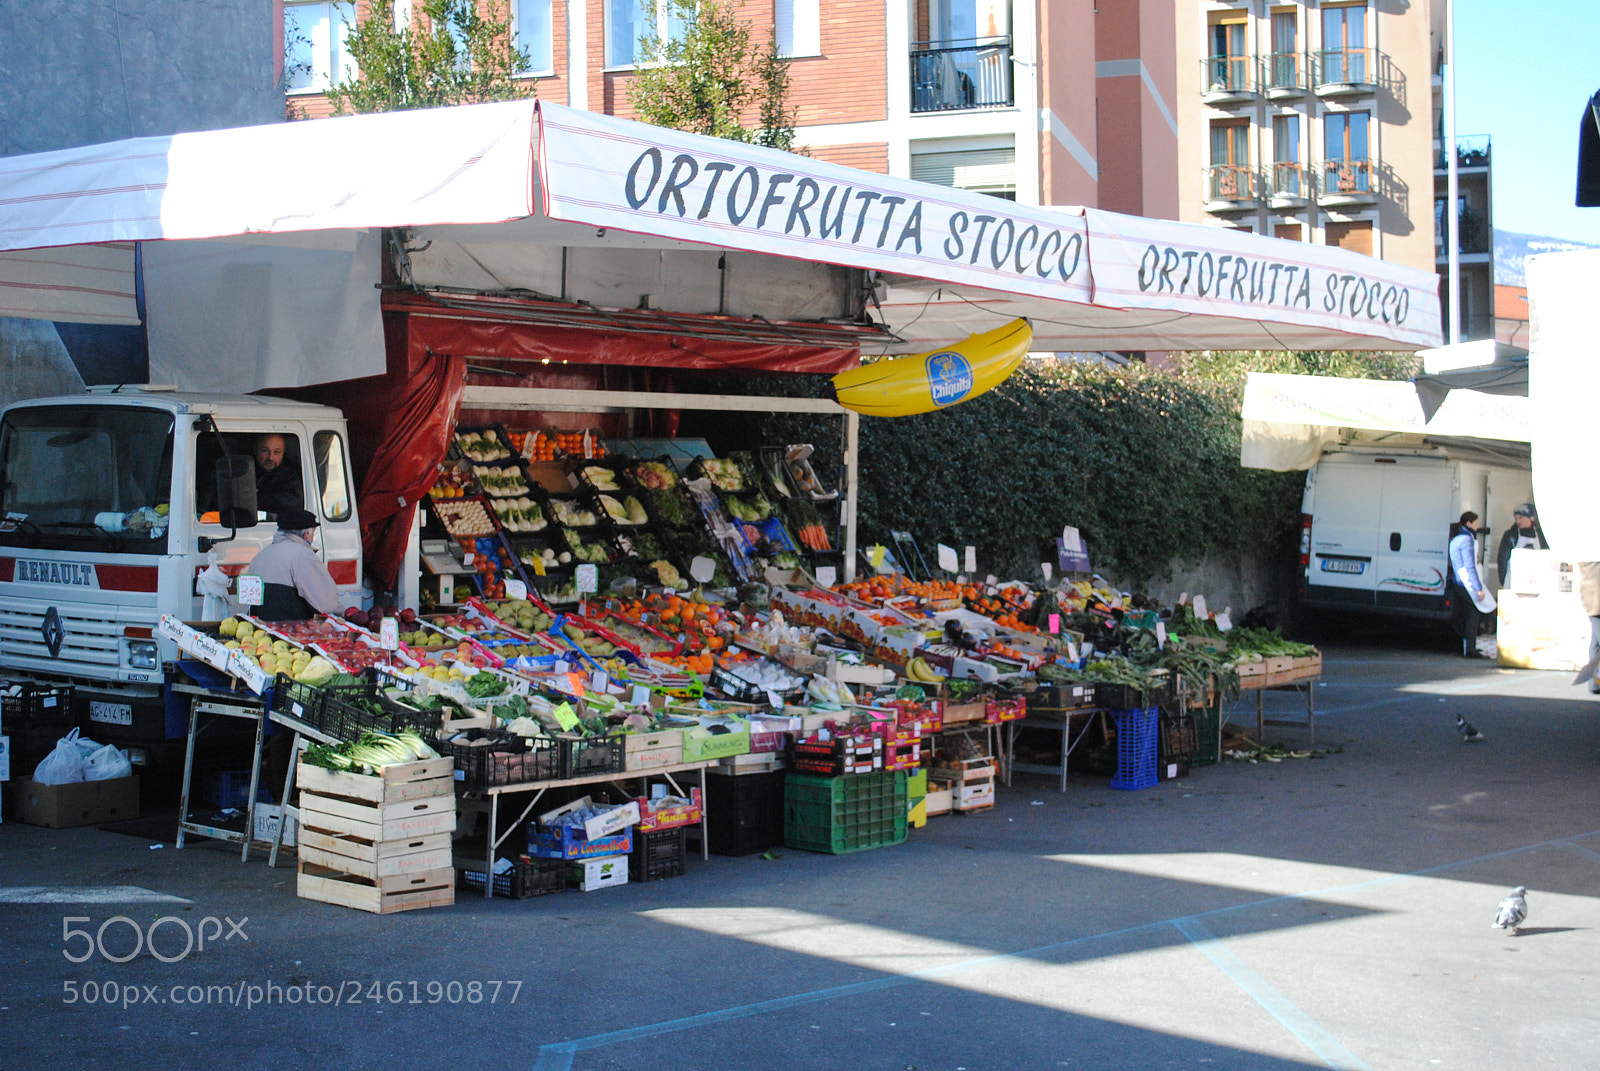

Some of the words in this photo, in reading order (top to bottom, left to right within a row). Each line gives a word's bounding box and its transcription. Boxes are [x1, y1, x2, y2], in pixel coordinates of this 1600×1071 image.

[625, 147, 923, 255] ORTOFRUTTA
[944, 211, 1082, 282] STOCCO
[1138, 244, 1311, 310] ORTOFRUTTA
[1324, 273, 1410, 326] STOCCO
[932, 376, 972, 400] Chiquita
[18, 560, 91, 585] RENAULT
[163, 620, 184, 638] Melinda
[196, 639, 217, 656] Melinda
[233, 657, 254, 680] Melinda
[568, 843, 578, 856] La
[581, 840, 621, 855] Coccinella
